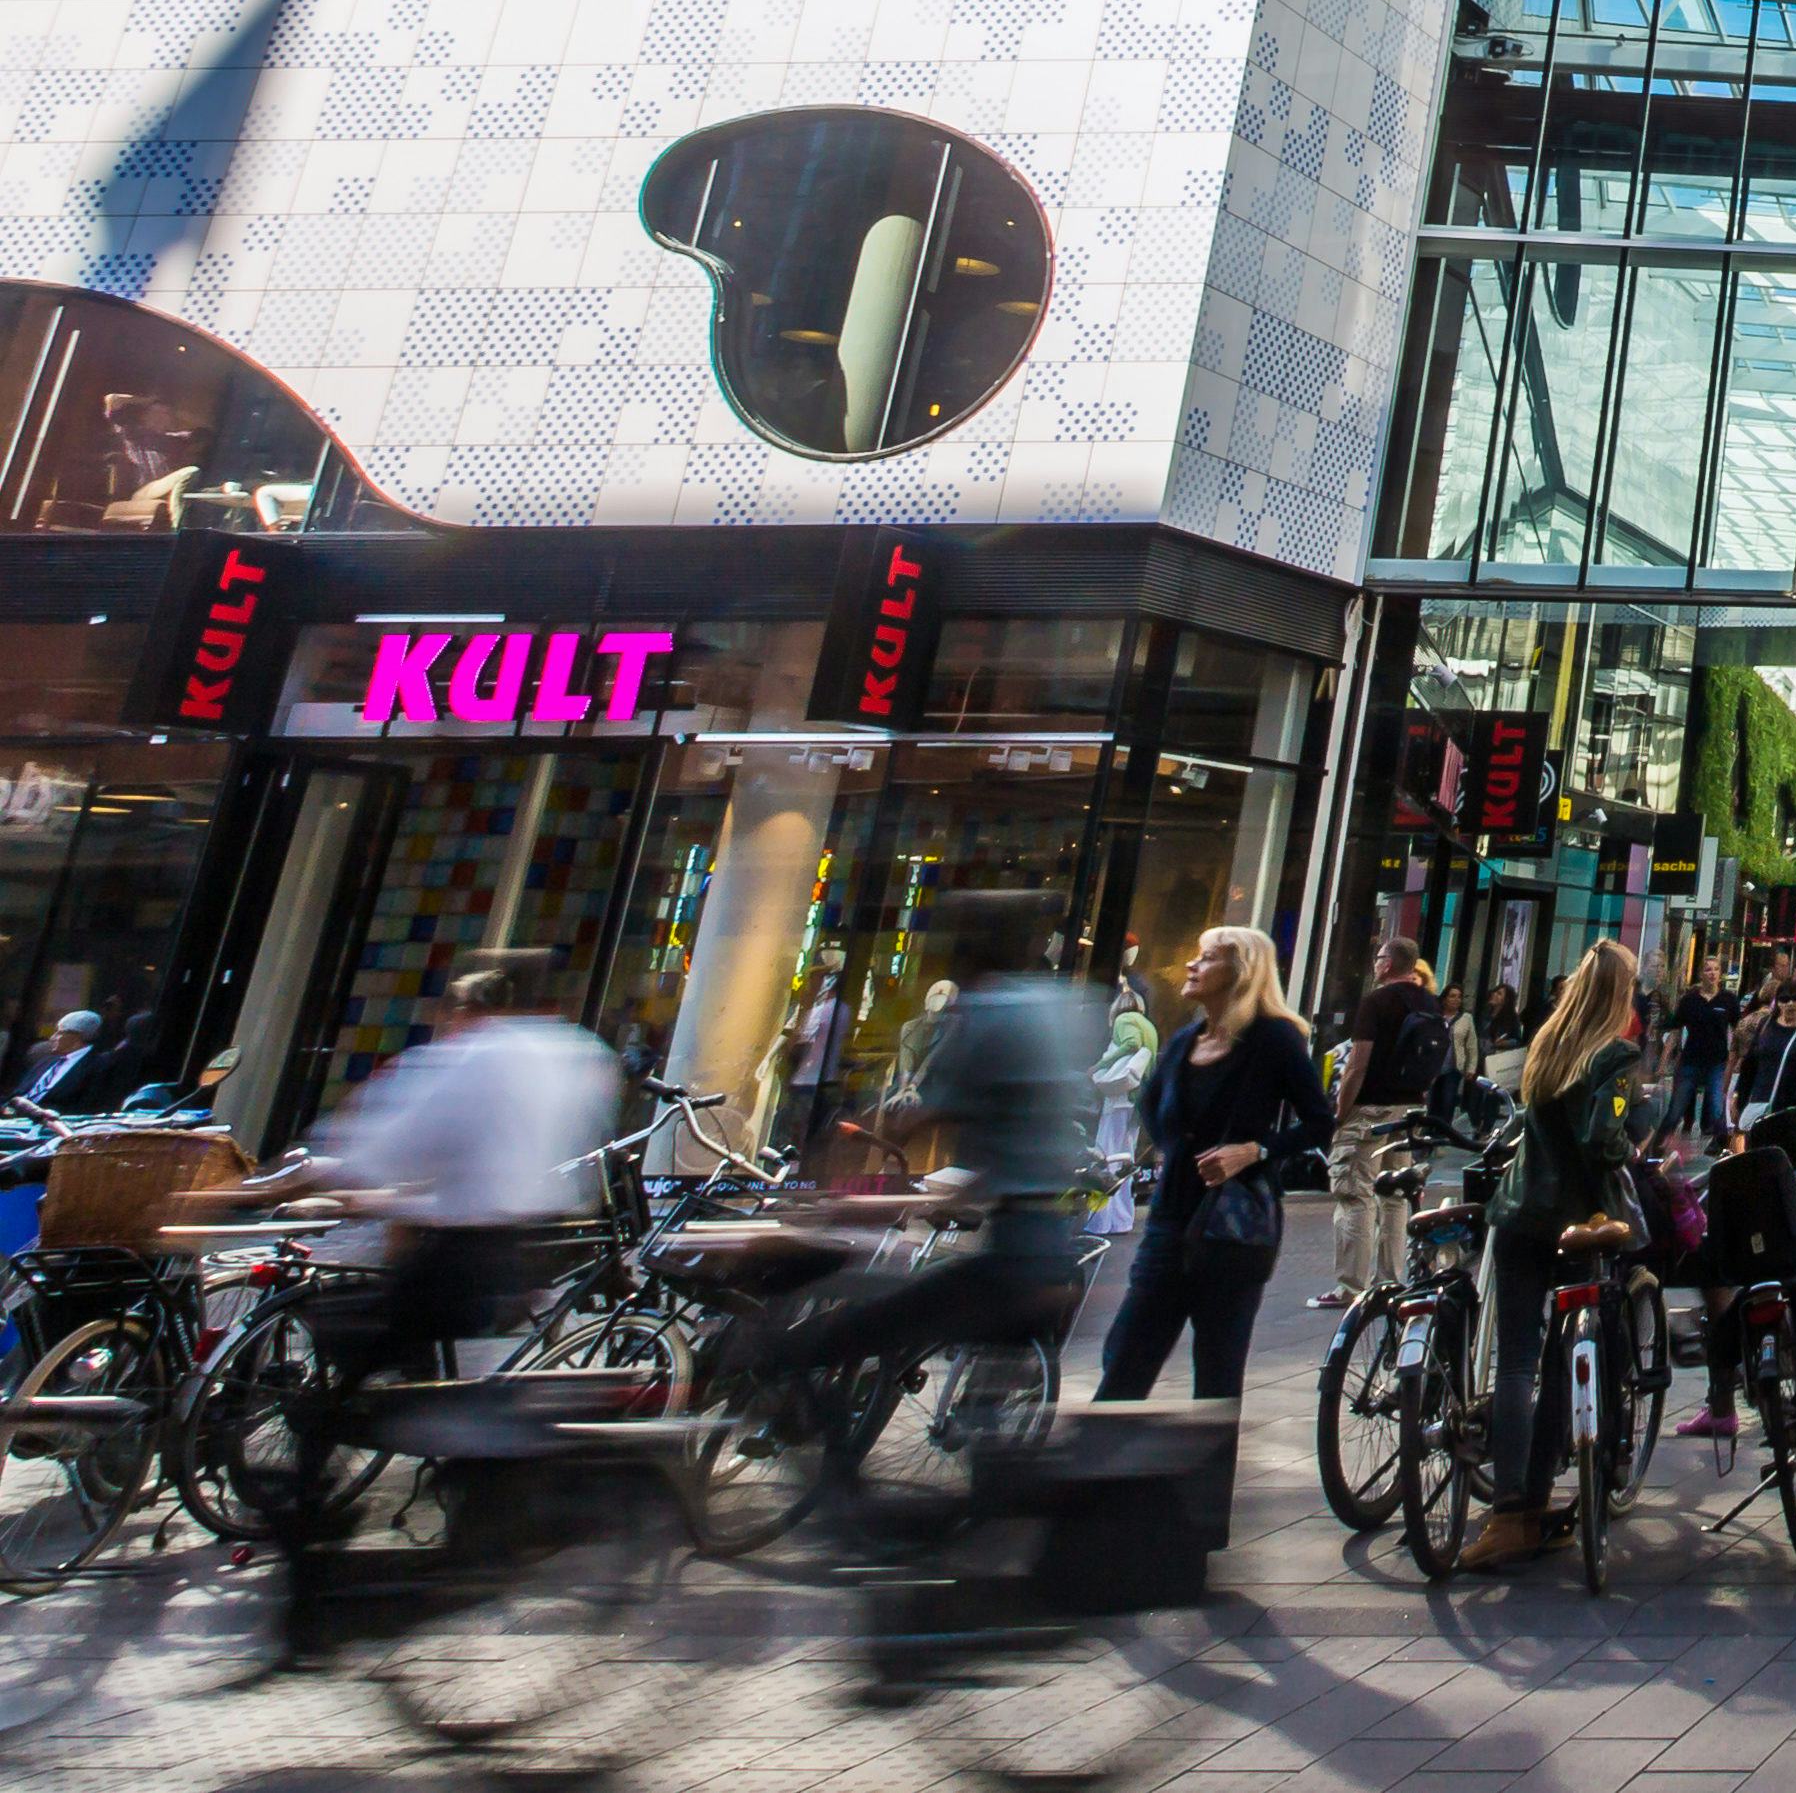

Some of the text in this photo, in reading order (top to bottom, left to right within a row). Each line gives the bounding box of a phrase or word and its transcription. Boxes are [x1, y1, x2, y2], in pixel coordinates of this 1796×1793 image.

[179, 549, 267, 720] KULT
[363, 632, 674, 722] KULT
[859, 544, 923, 715] KULT
[1482, 719, 1527, 828] KULT
[1653, 860, 1697, 873] sacha
